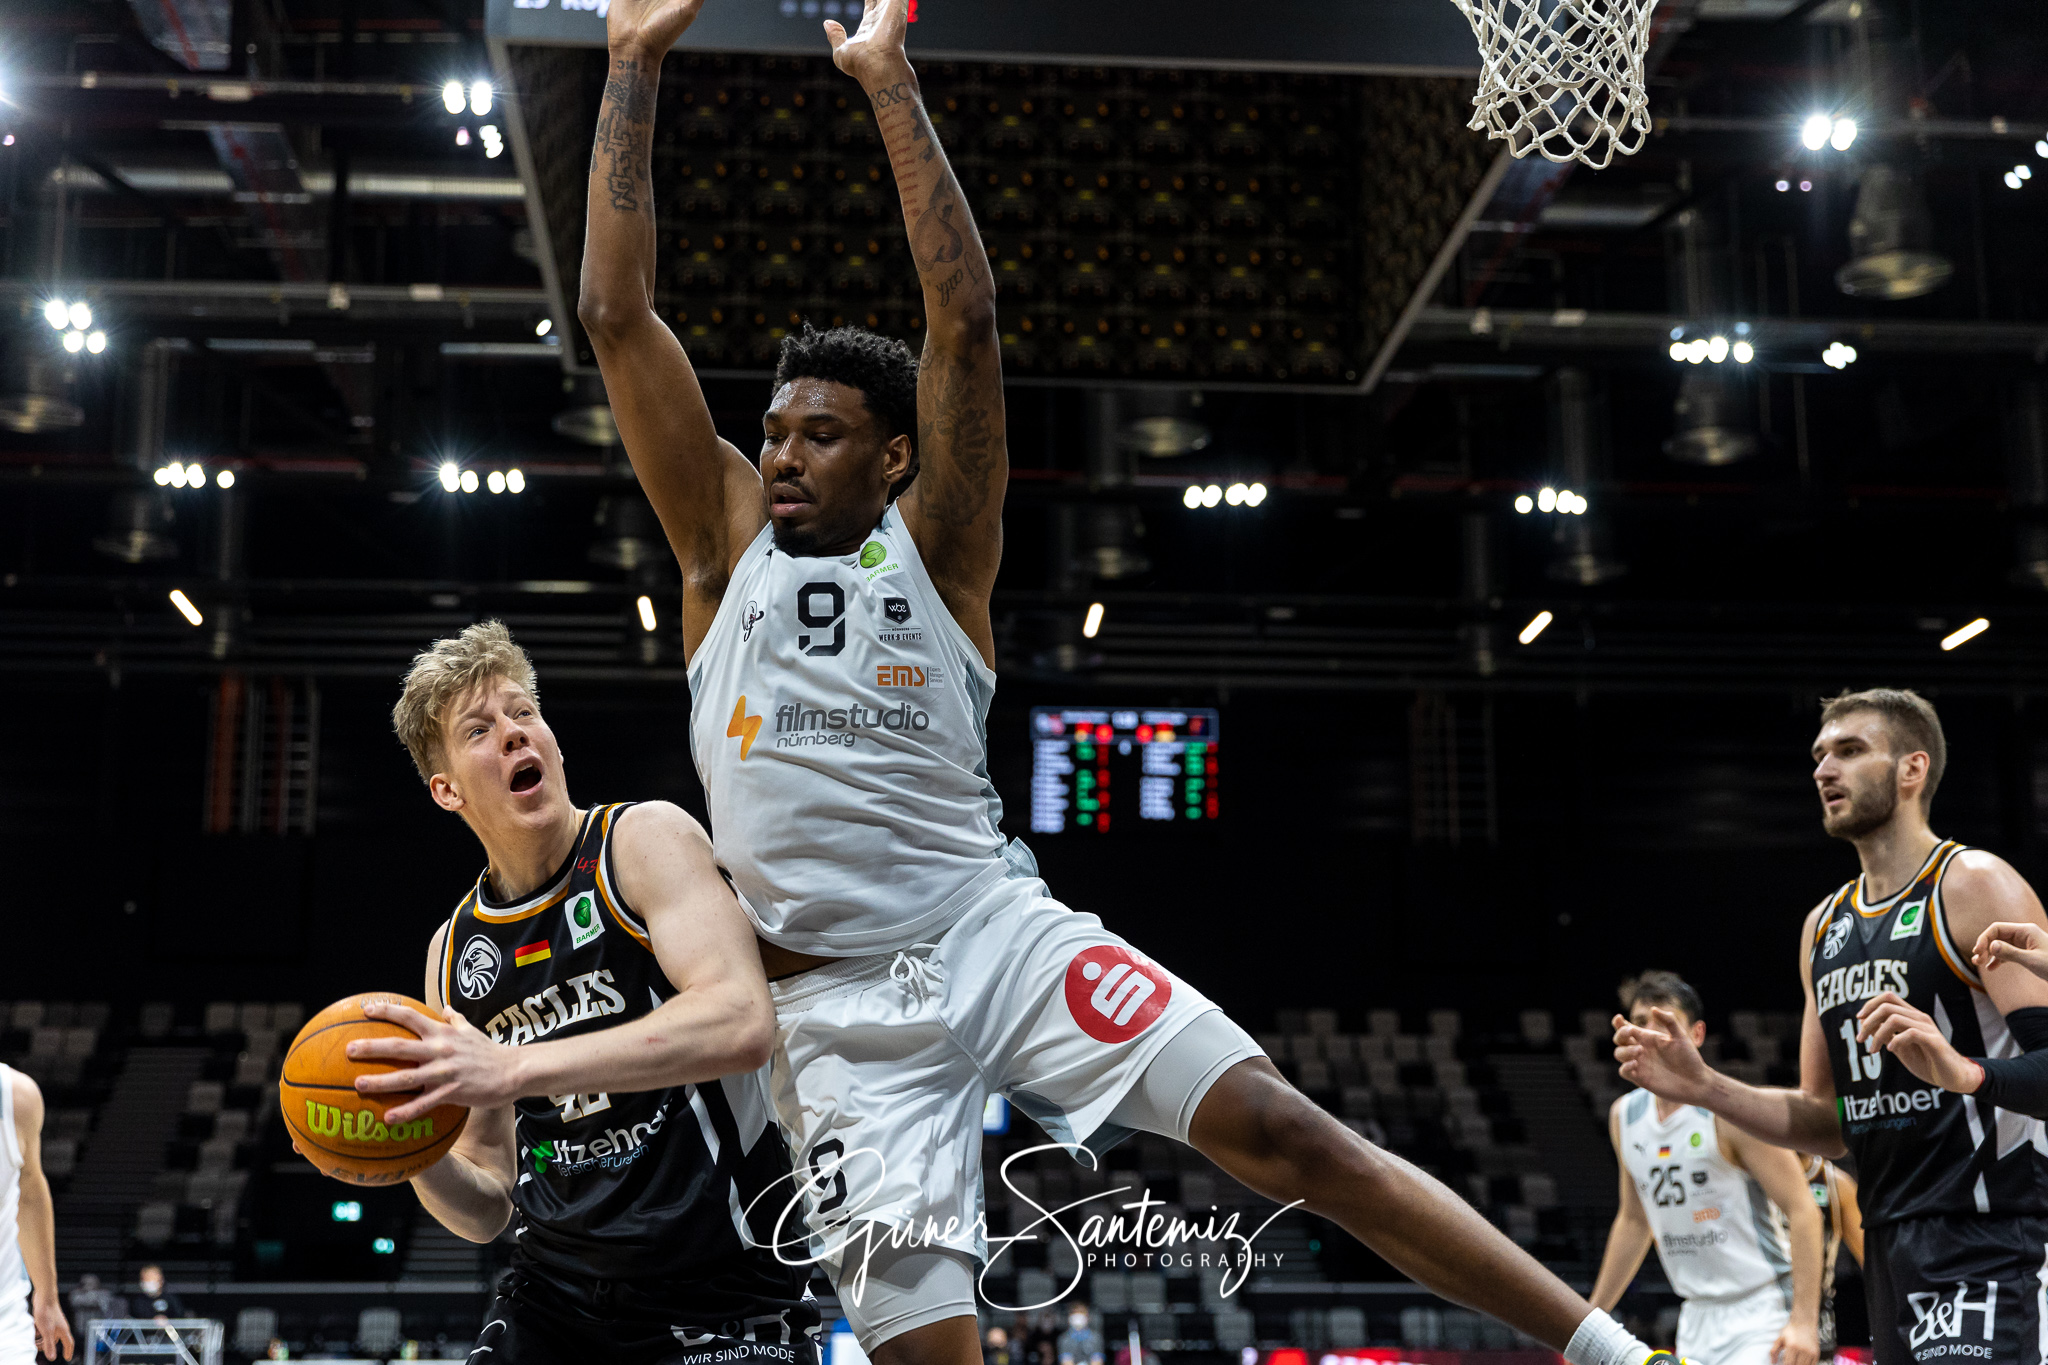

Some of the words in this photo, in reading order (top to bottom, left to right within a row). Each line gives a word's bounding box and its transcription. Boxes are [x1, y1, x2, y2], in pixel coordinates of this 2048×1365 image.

[797, 581, 847, 657] 9
[902, 632, 922, 641] EVENTS
[876, 665, 926, 687] EMS
[775, 702, 930, 733] filmstudio
[776, 732, 856, 748] nürnberg
[576, 856, 599, 875] 43
[576, 923, 601, 944] BARMER
[1816, 958, 1910, 1018] EAGLES
[485, 968, 627, 1047] EAGLES
[1843, 1087, 1945, 1122] Itzehoer
[306, 1099, 434, 1142] Wilson
[1649, 1164, 1686, 1207] 25
[1907, 1280, 1999, 1350] B&H
[683, 1352, 712, 1365] WIR
[715, 1345, 750, 1362] SIND
[753, 1344, 796, 1364] MODE
[1949, 1344, 1993, 1360] MODE
